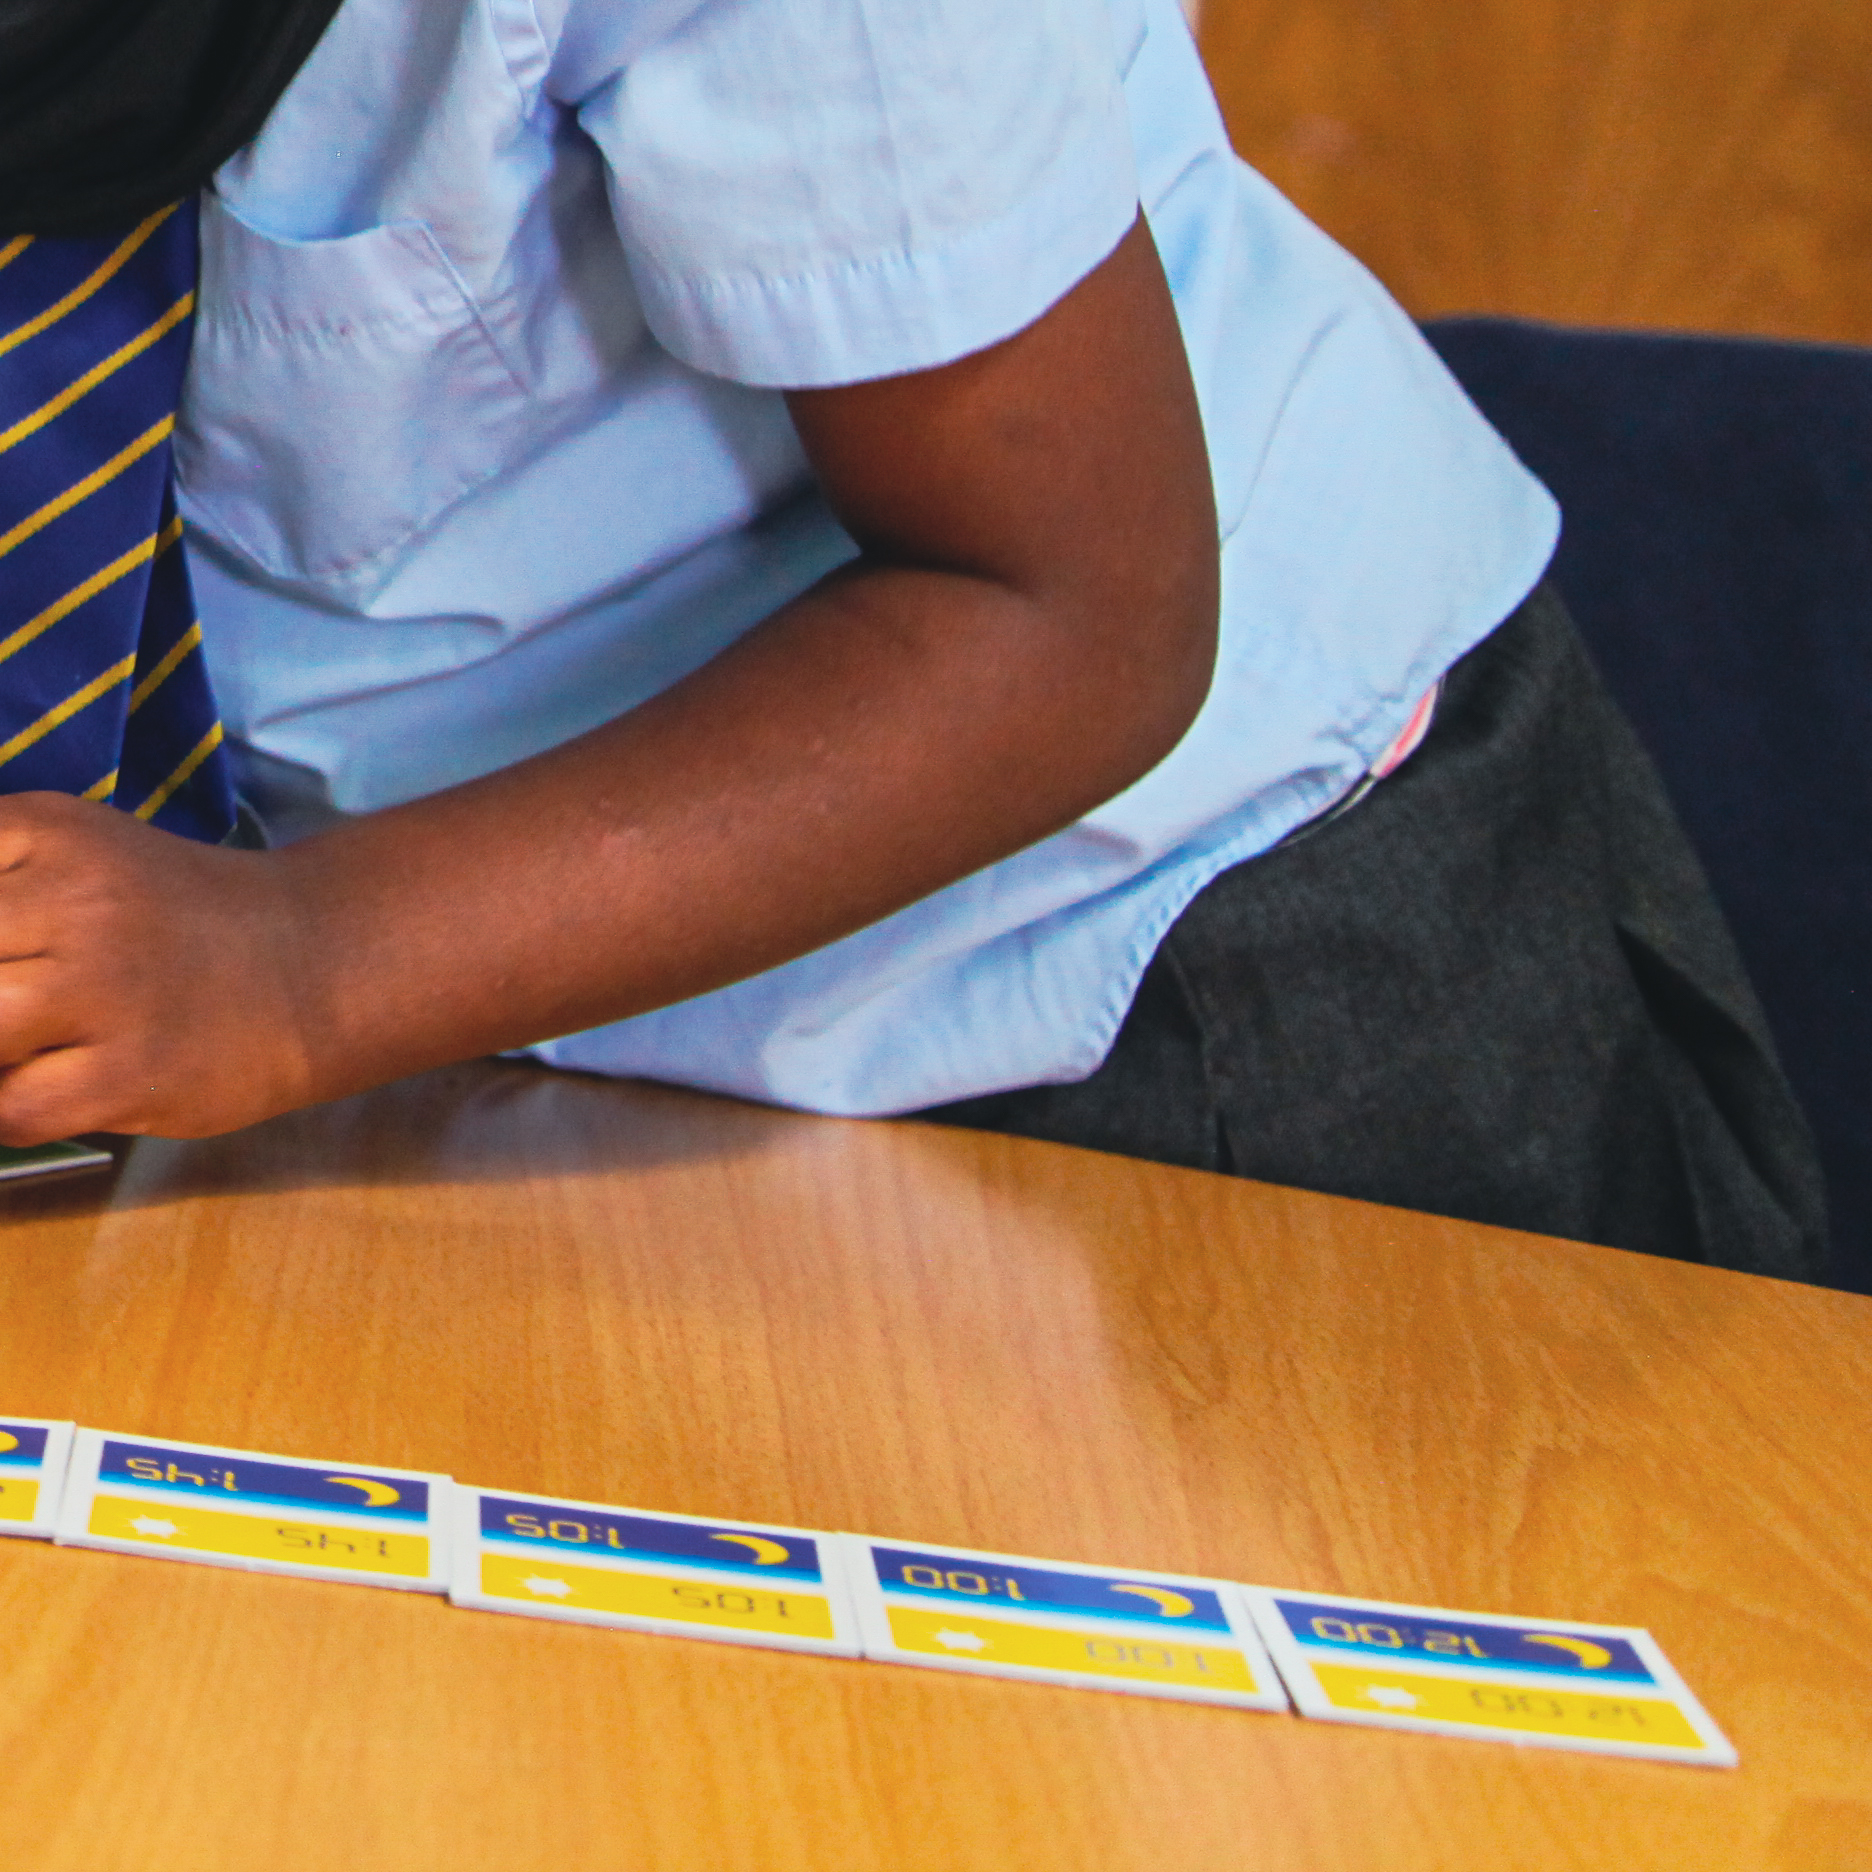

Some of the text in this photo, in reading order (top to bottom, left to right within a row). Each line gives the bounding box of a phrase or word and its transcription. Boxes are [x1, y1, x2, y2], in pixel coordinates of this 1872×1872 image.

[126, 1457, 239, 1492] 1:45
[276, 1527, 392, 1558] 1:45
[505, 1514, 624, 1549] 1:05
[902, 1565, 1026, 1601] 1:00
[671, 1586, 792, 1618] 1:05
[1311, 1617, 1490, 1660] 12:00
